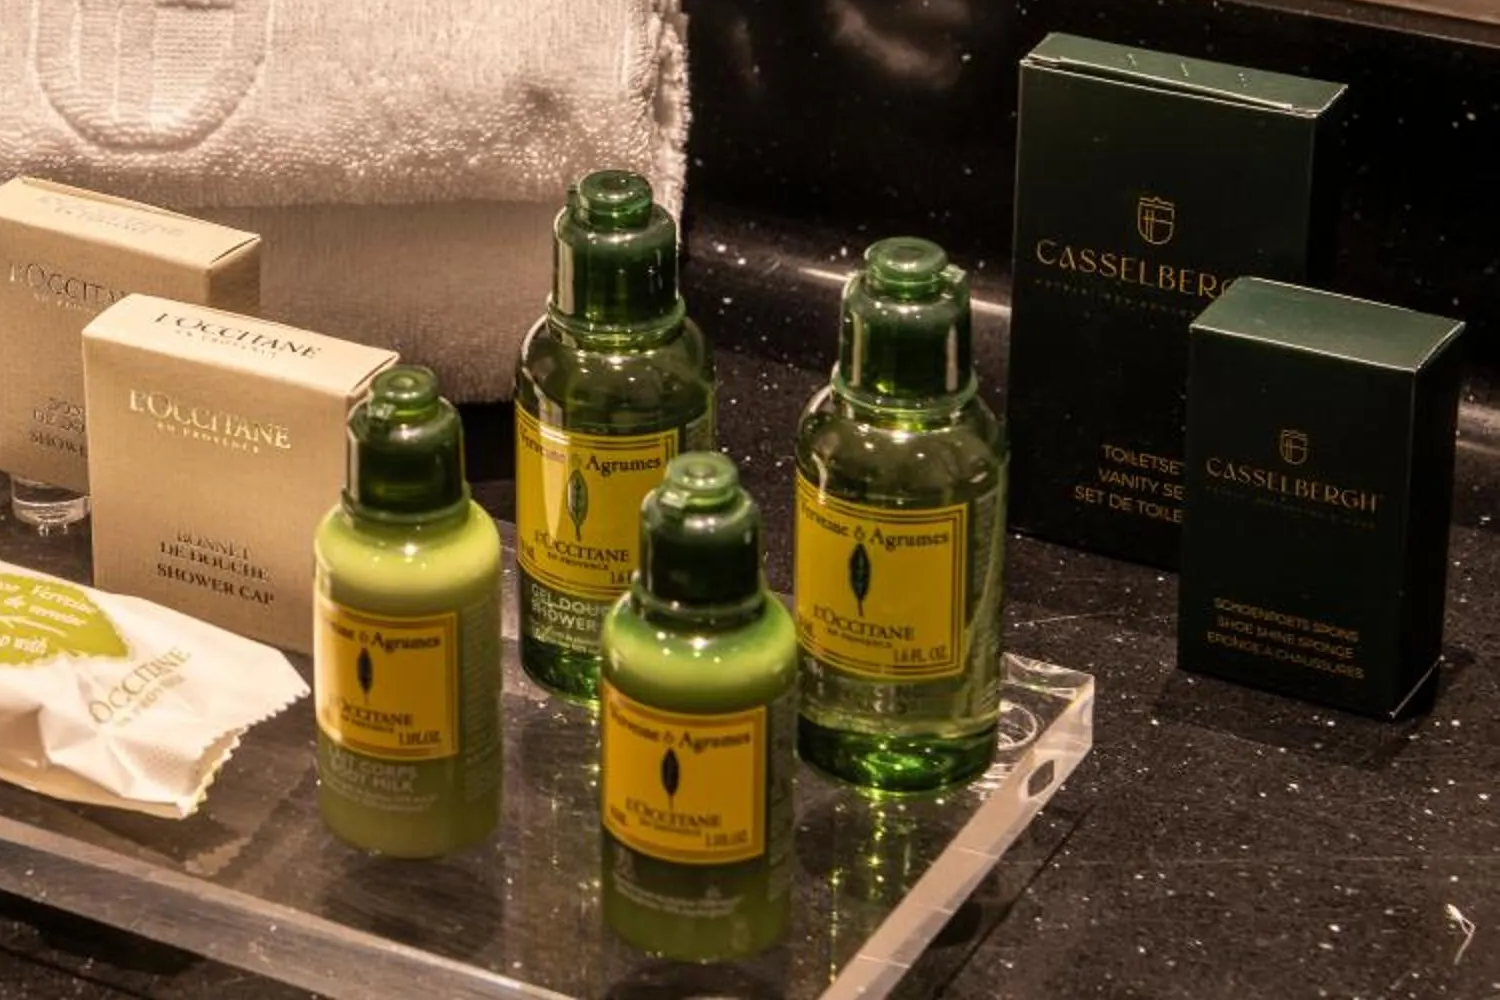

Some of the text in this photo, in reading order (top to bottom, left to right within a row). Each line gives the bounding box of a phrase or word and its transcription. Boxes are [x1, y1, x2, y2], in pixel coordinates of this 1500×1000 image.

[1036, 239, 1230, 298] CASSELBER
[129, 389, 291, 450] L'OCCITANE
[1074, 485, 1106, 505] SET
[1109, 493, 1134, 511] DE
[1135, 499, 1185, 523] TOILE
[1098, 467, 1186, 501] VANITY SE
[1205, 457, 1378, 513] CASSELBERGH
[157, 562, 275, 605] SHOWER CAP
